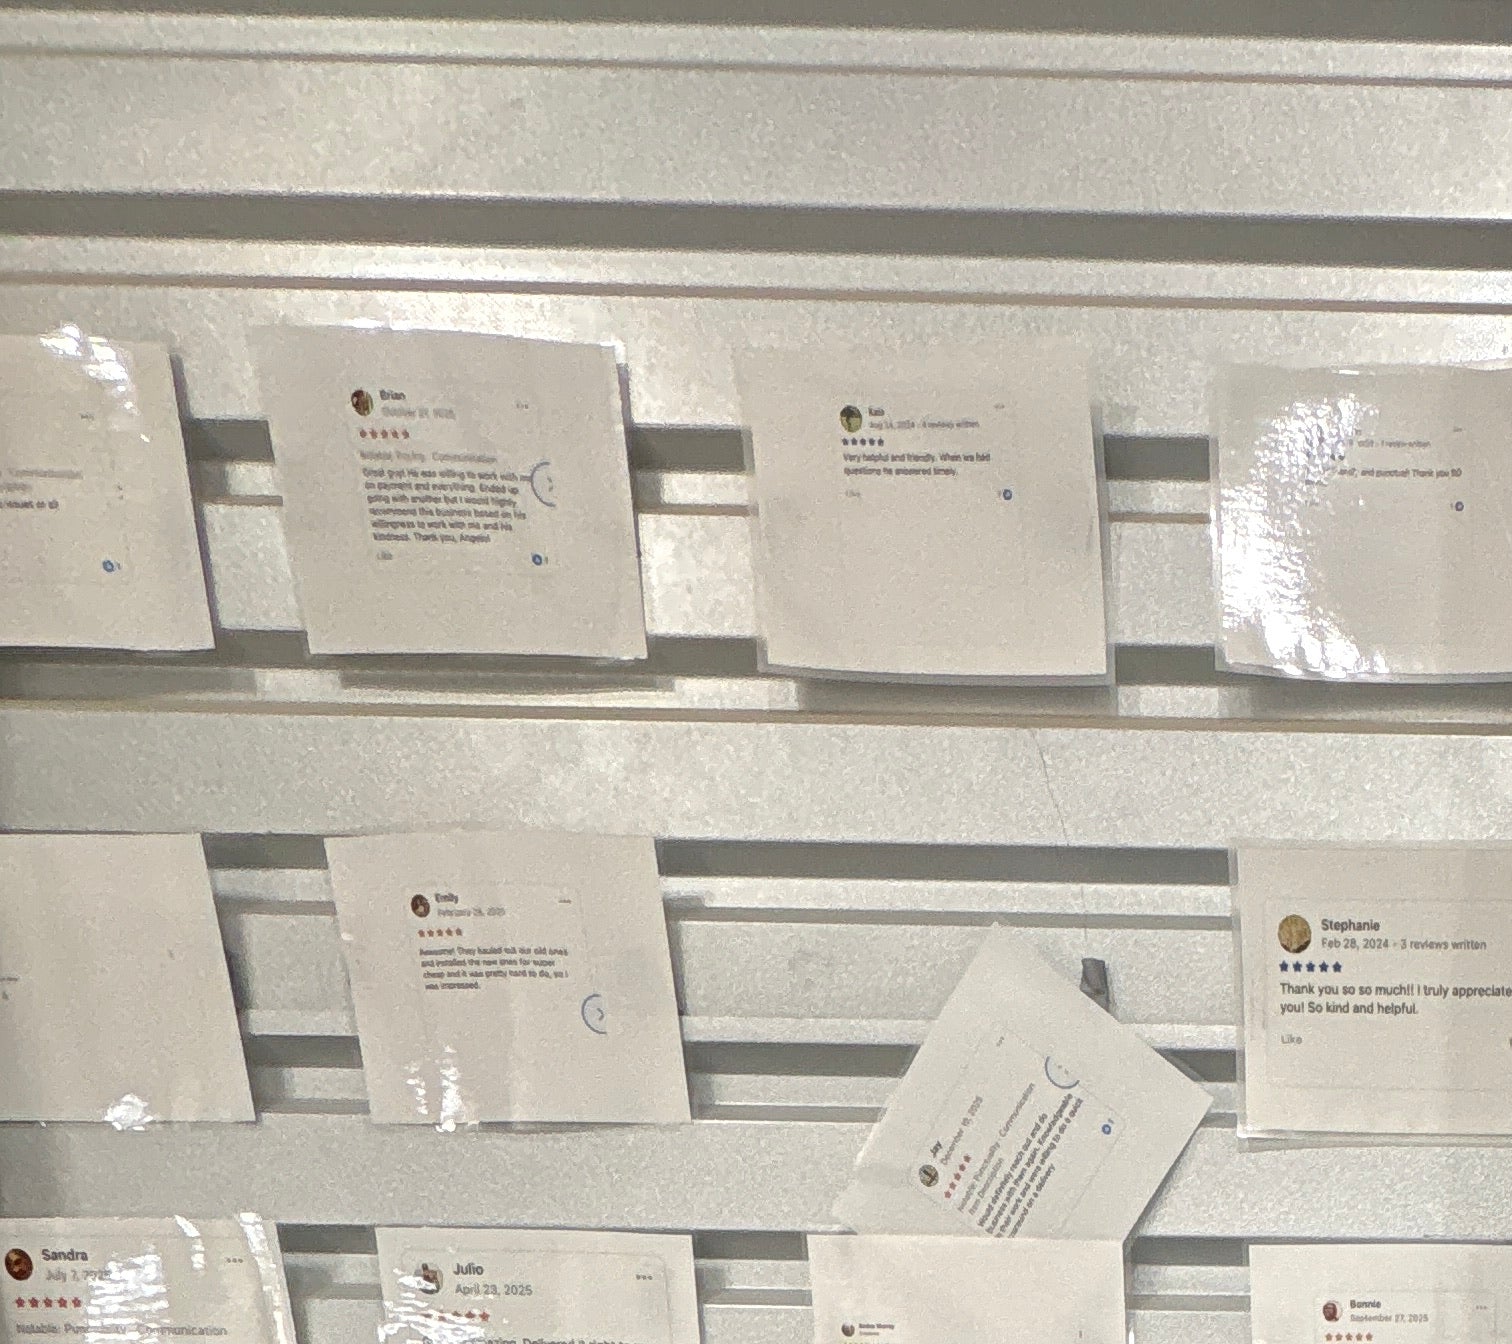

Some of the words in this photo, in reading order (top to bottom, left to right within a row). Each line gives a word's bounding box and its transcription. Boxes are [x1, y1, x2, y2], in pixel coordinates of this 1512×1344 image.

[1321, 919, 1380, 933] Stephanie
[1321, 937, 1340, 948] Feb
[1362, 937, 1388, 949] 2024
[1400, 937, 1406, 949] 3
[1409, 938, 1448, 949] reviews
[1451, 939, 1486, 949] written
[1281, 983, 1314, 994] Thank
[1318, 986, 1338, 997] you
[1342, 986, 1355, 995] so
[1358, 986, 1372, 995] so
[1423, 985, 1448, 998] truly
[1452, 986, 1512, 999] appreciate
[1307, 1002, 1323, 1013] So
[1325, 1002, 1349, 1013] kind
[1352, 1003, 1374, 1013] and
[1281, 1032, 1302, 1044] Like
[41, 1249, 88, 1261] Sandra
[453, 1263, 483, 1275] Julio
[455, 1283, 480, 1297] April
[504, 1283, 532, 1295] 2025
[1349, 1299, 1381, 1308] Bonnie
